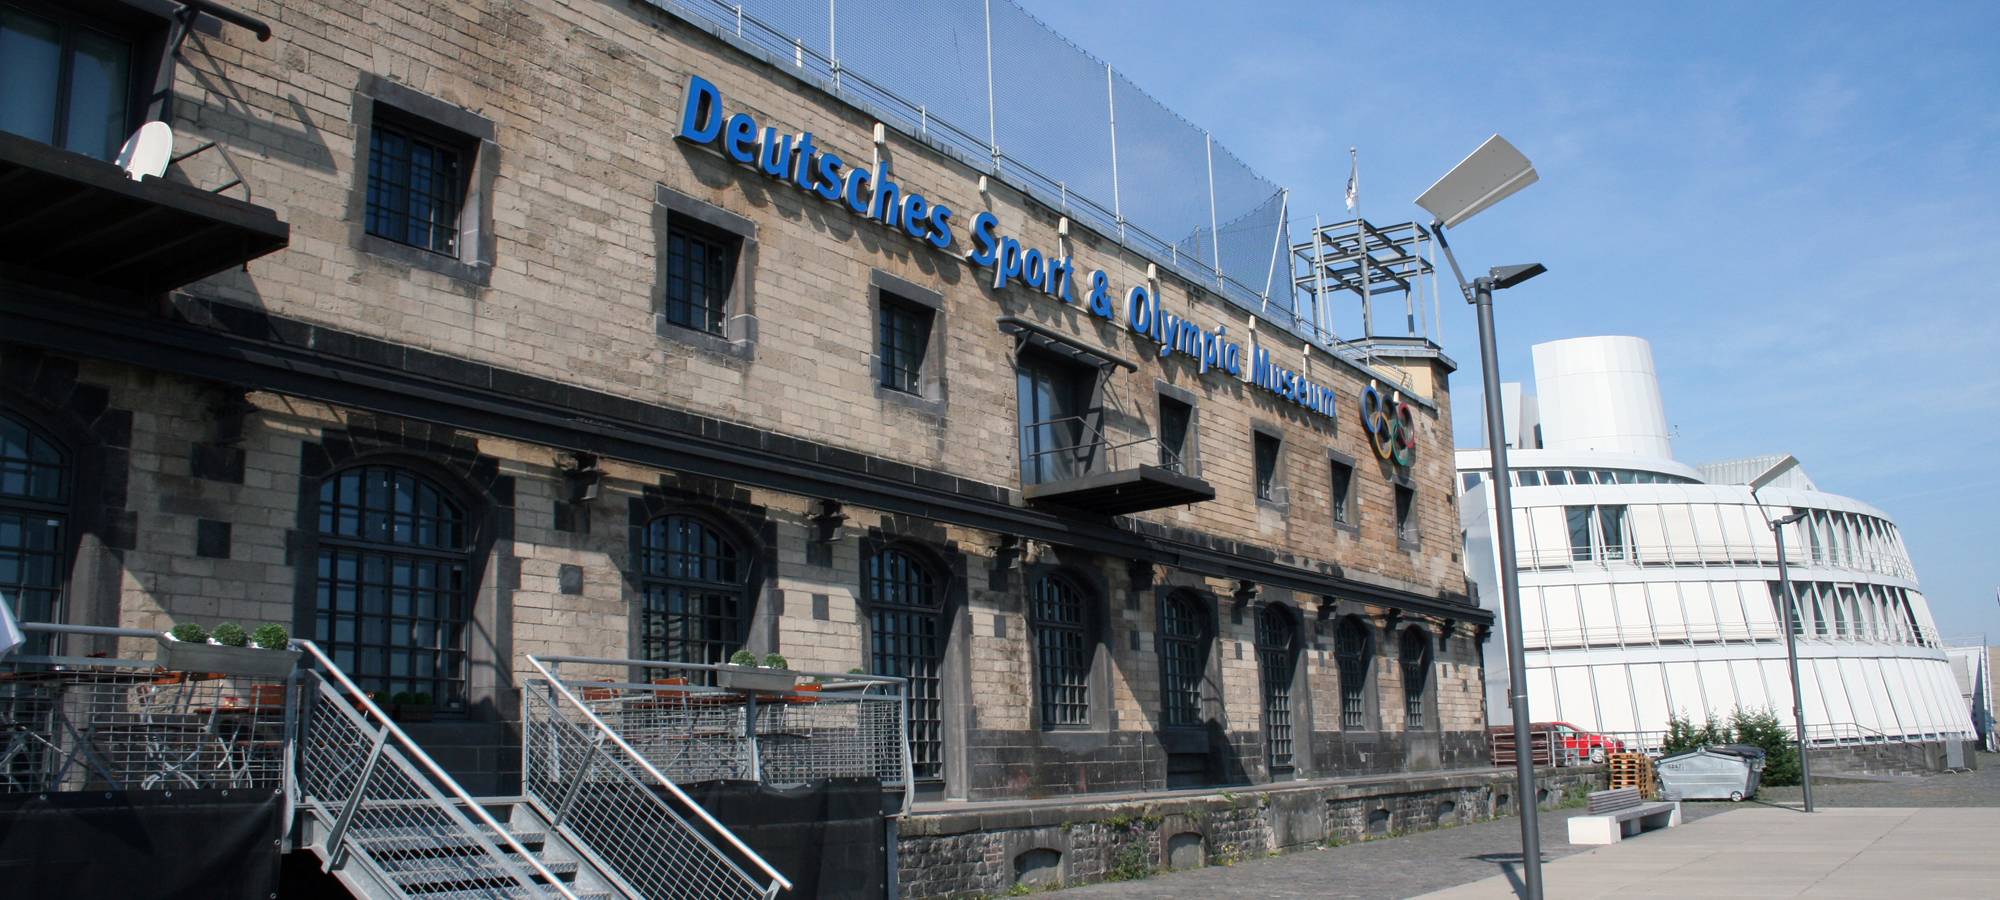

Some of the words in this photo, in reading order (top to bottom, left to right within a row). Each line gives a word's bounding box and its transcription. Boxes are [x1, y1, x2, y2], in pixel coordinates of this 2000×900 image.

[677, 73, 953, 249] Deutsches
[968, 211, 1075, 303] Sport
[1087, 269, 1114, 320] &
[1127, 286, 1241, 376] Olympia
[1249, 344, 1336, 418] Museum
